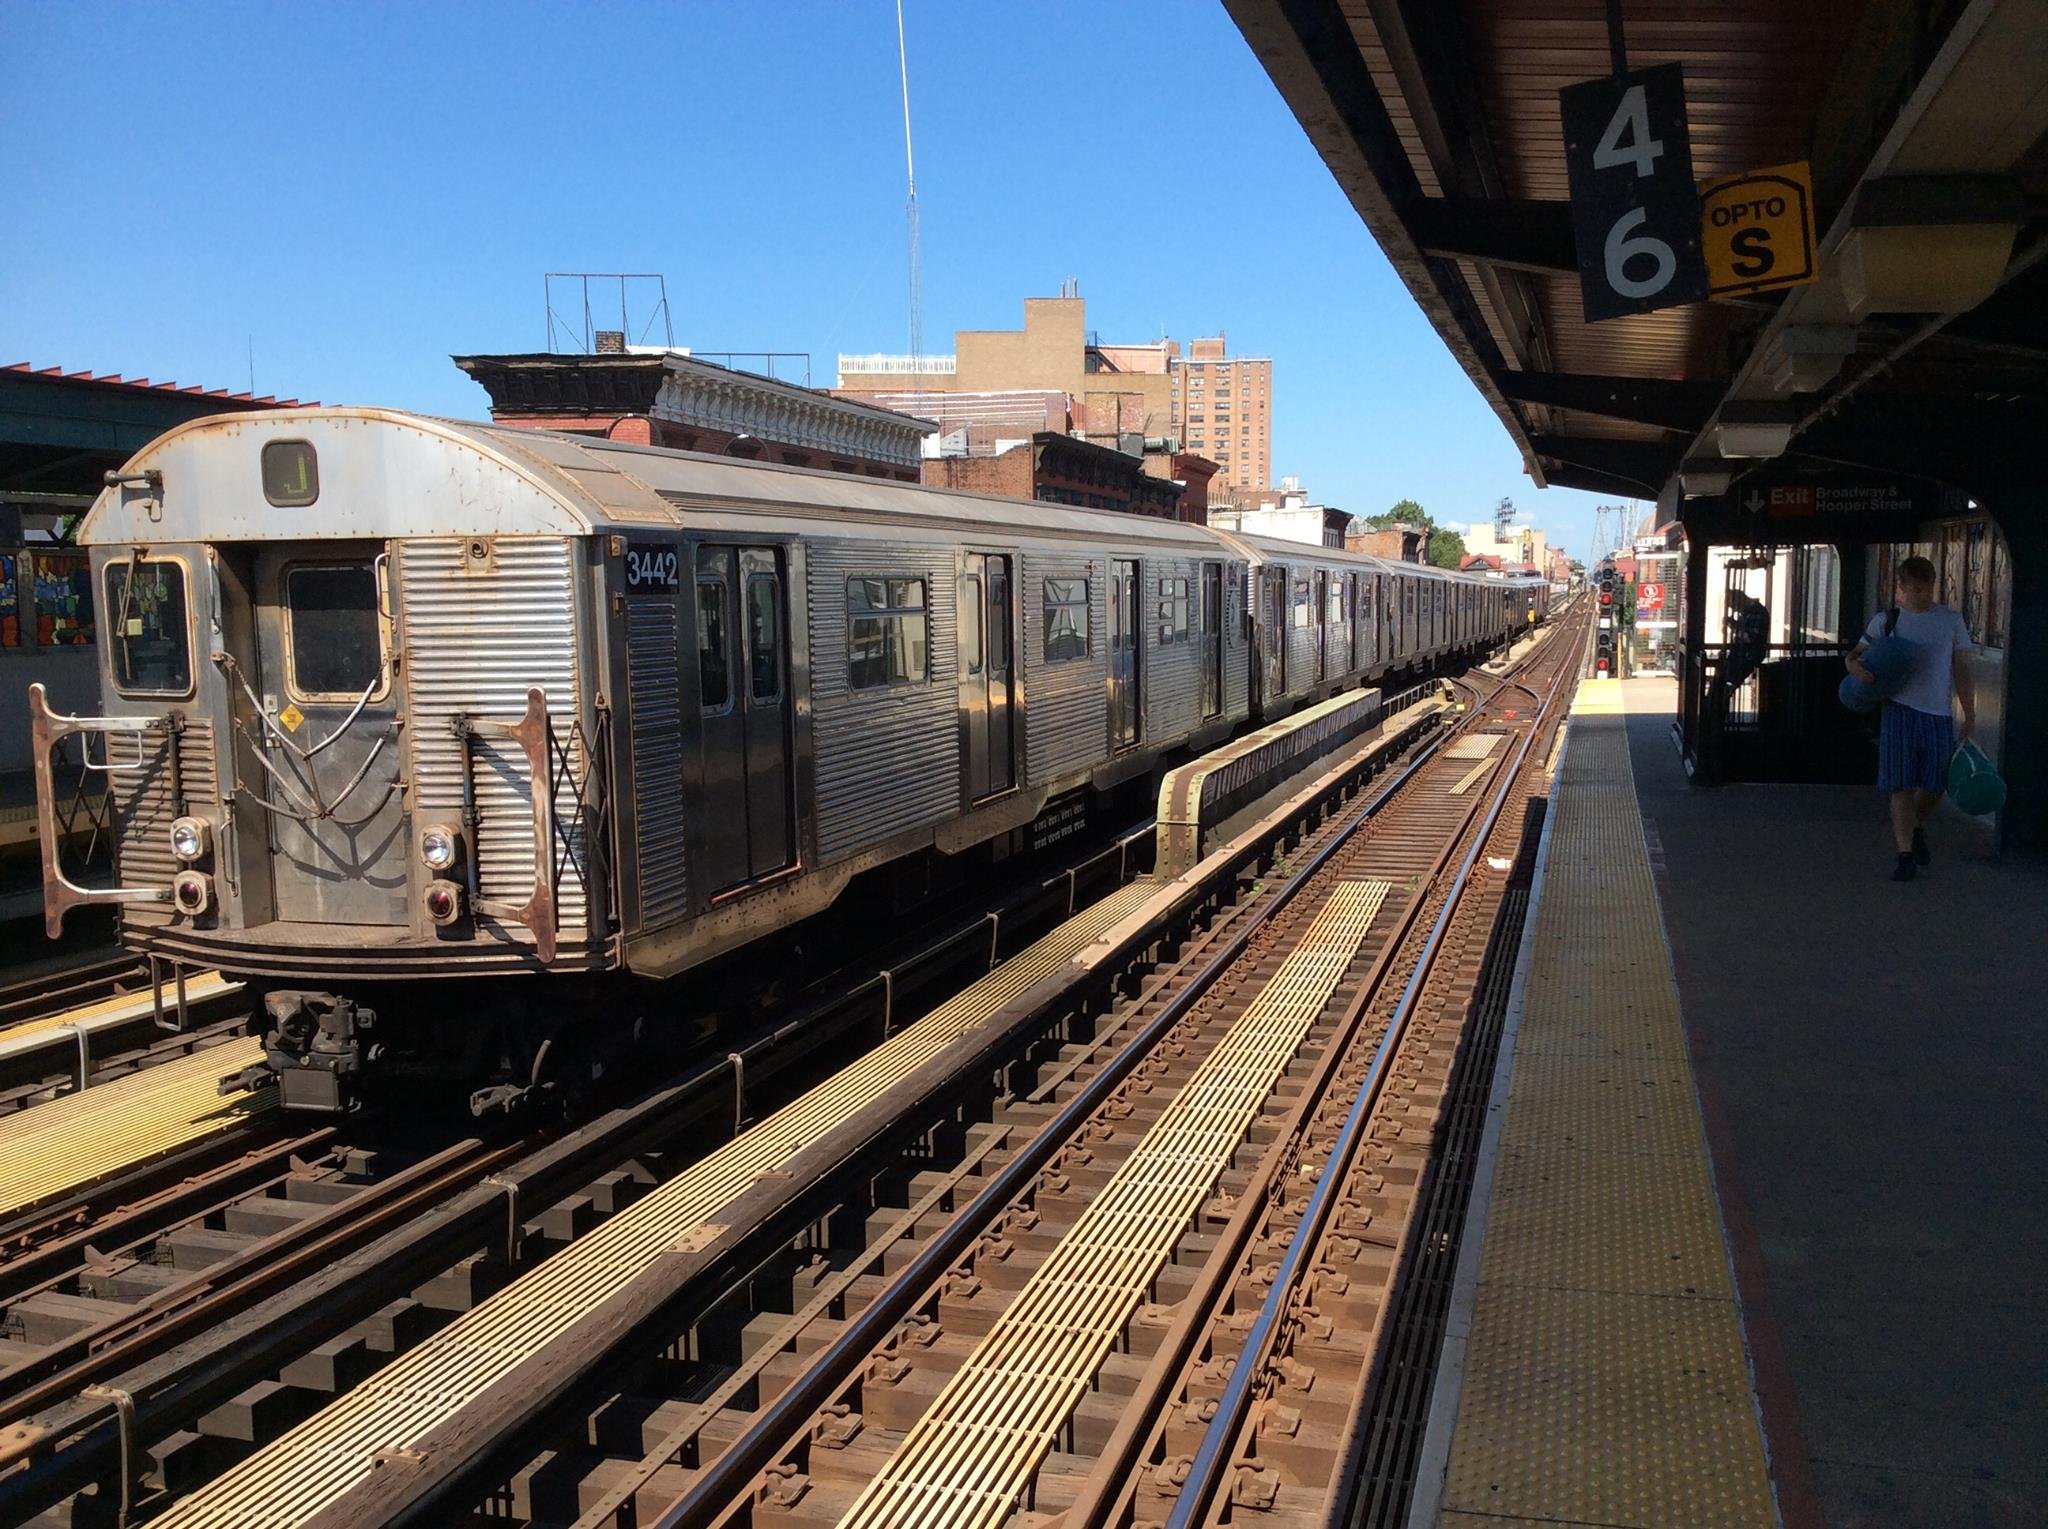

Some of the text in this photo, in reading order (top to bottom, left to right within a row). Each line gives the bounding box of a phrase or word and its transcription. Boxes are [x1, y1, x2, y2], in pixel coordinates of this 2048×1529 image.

[1593, 84, 1664, 178] 4
[1711, 197, 1786, 227] OPTO
[1604, 206, 1677, 298] 6
[1731, 227, 1775, 278] S
[283, 453, 307, 493] J
[1770, 487, 1809, 505] Exit
[1815, 498, 1913, 513] Hooper Street
[1816, 486, 1898, 500] Broadway &
[627, 551, 678, 585] 3442
